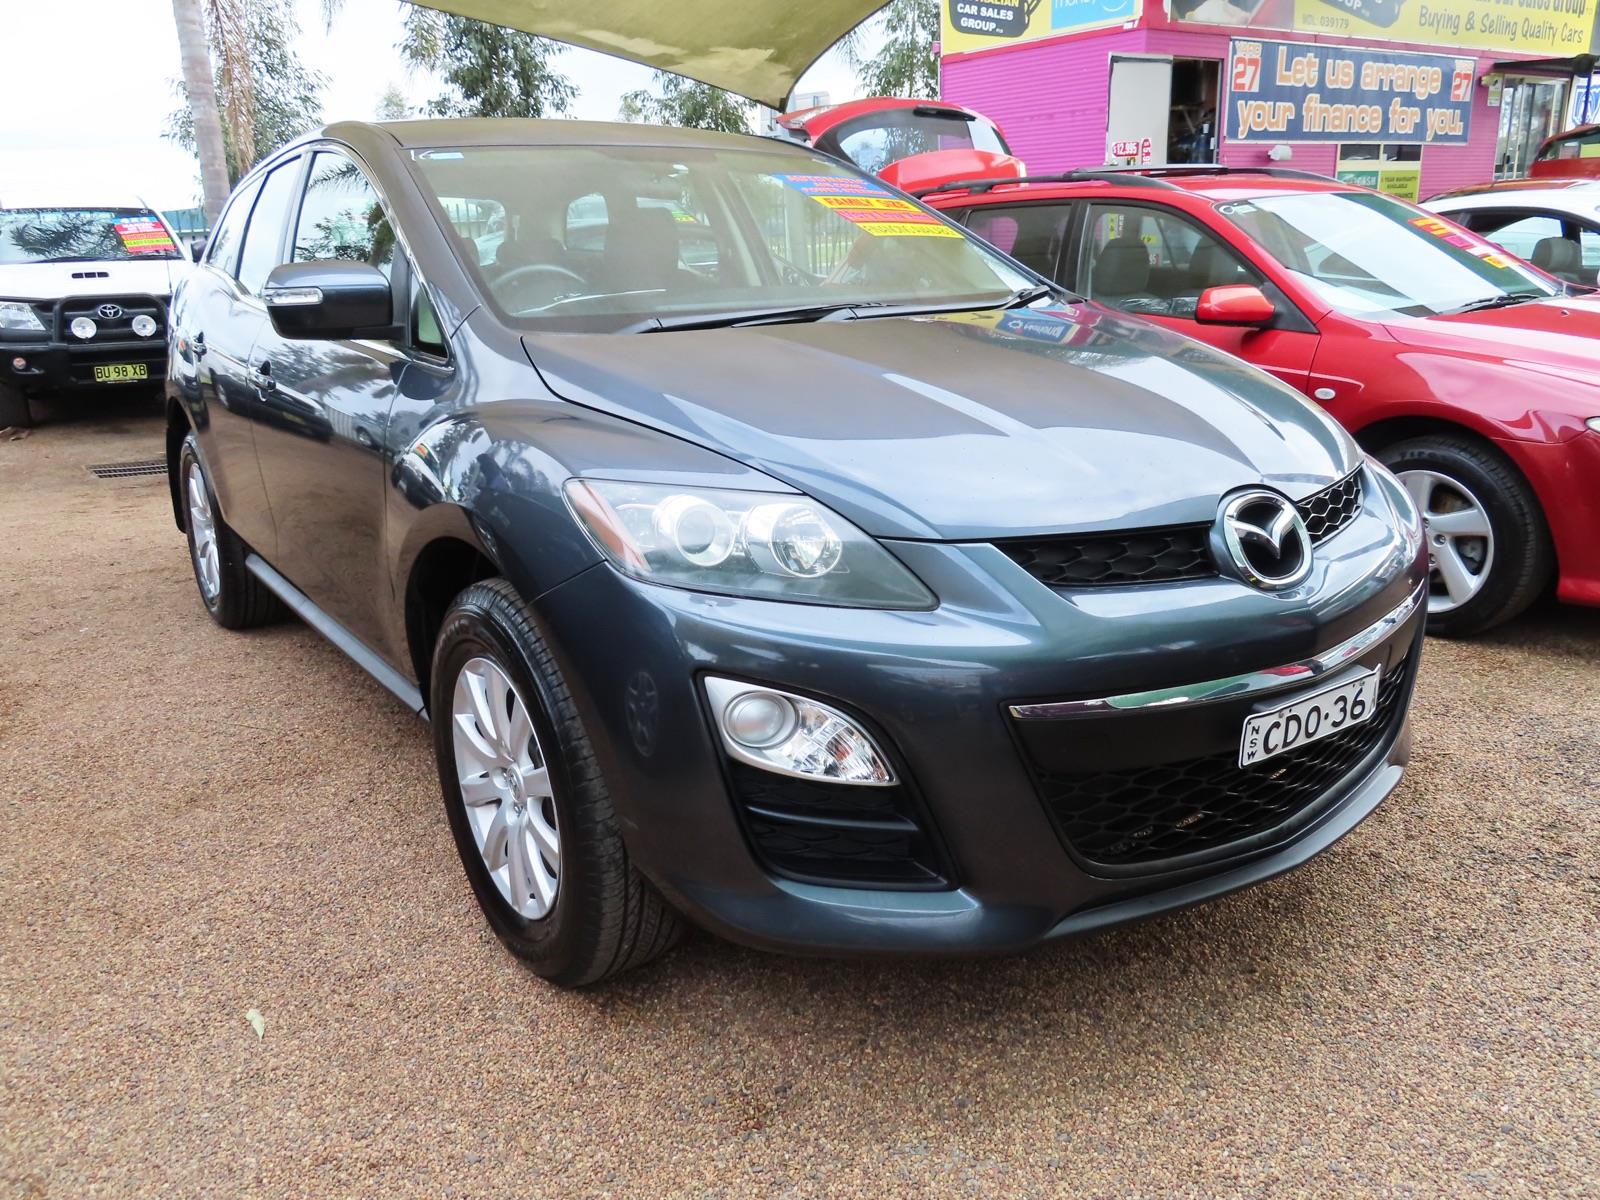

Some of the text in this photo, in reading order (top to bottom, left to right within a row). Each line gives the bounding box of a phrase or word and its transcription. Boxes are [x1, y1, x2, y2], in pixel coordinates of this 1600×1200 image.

[957, 3, 978, 15] CAR
[980, 6, 1014, 20] SALES
[961, 17, 996, 31] GROUP
[1419, 5, 1583, 46] Buying & Selling Quality Cars
[1234, 57, 1260, 91] 27
[1276, 46, 1319, 88] Let
[1325, 59, 1354, 89] us
[1360, 61, 1442, 99] arrange
[1452, 72, 1472, 100] 27
[1237, 94, 1464, 141] your finance for you.
